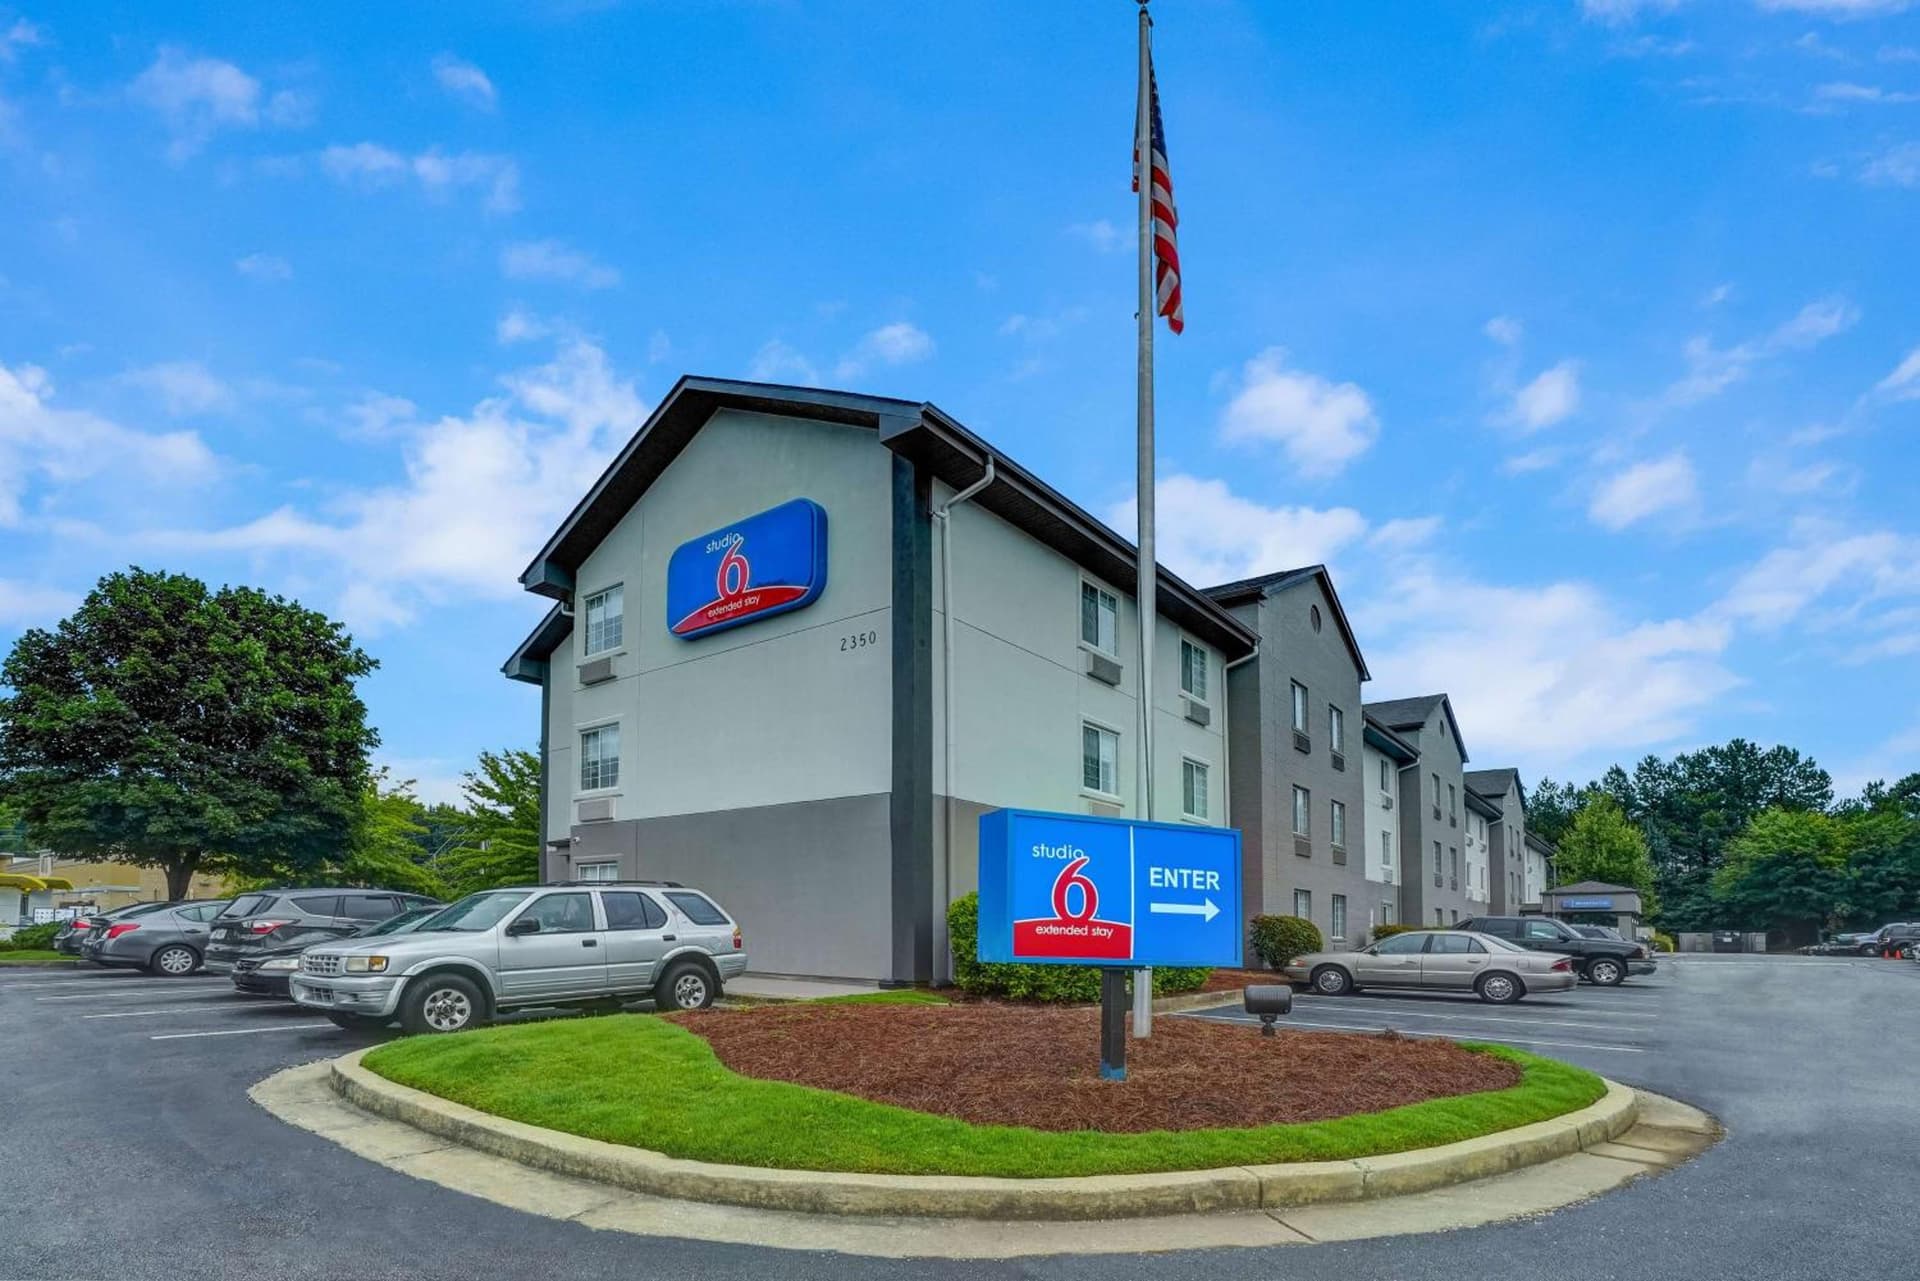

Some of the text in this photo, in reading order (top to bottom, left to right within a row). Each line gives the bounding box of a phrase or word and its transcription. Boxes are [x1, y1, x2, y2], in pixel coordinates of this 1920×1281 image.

[706, 532, 741, 554] studio
[717, 536, 750, 600] 6
[707, 594, 761, 617] extended stay
[840, 631, 876, 651] 2350
[1032, 843, 1084, 860] studio
[1051, 856, 1099, 920] 6
[1149, 867, 1220, 891] ENTER
[1035, 924, 1114, 939] extended stay
